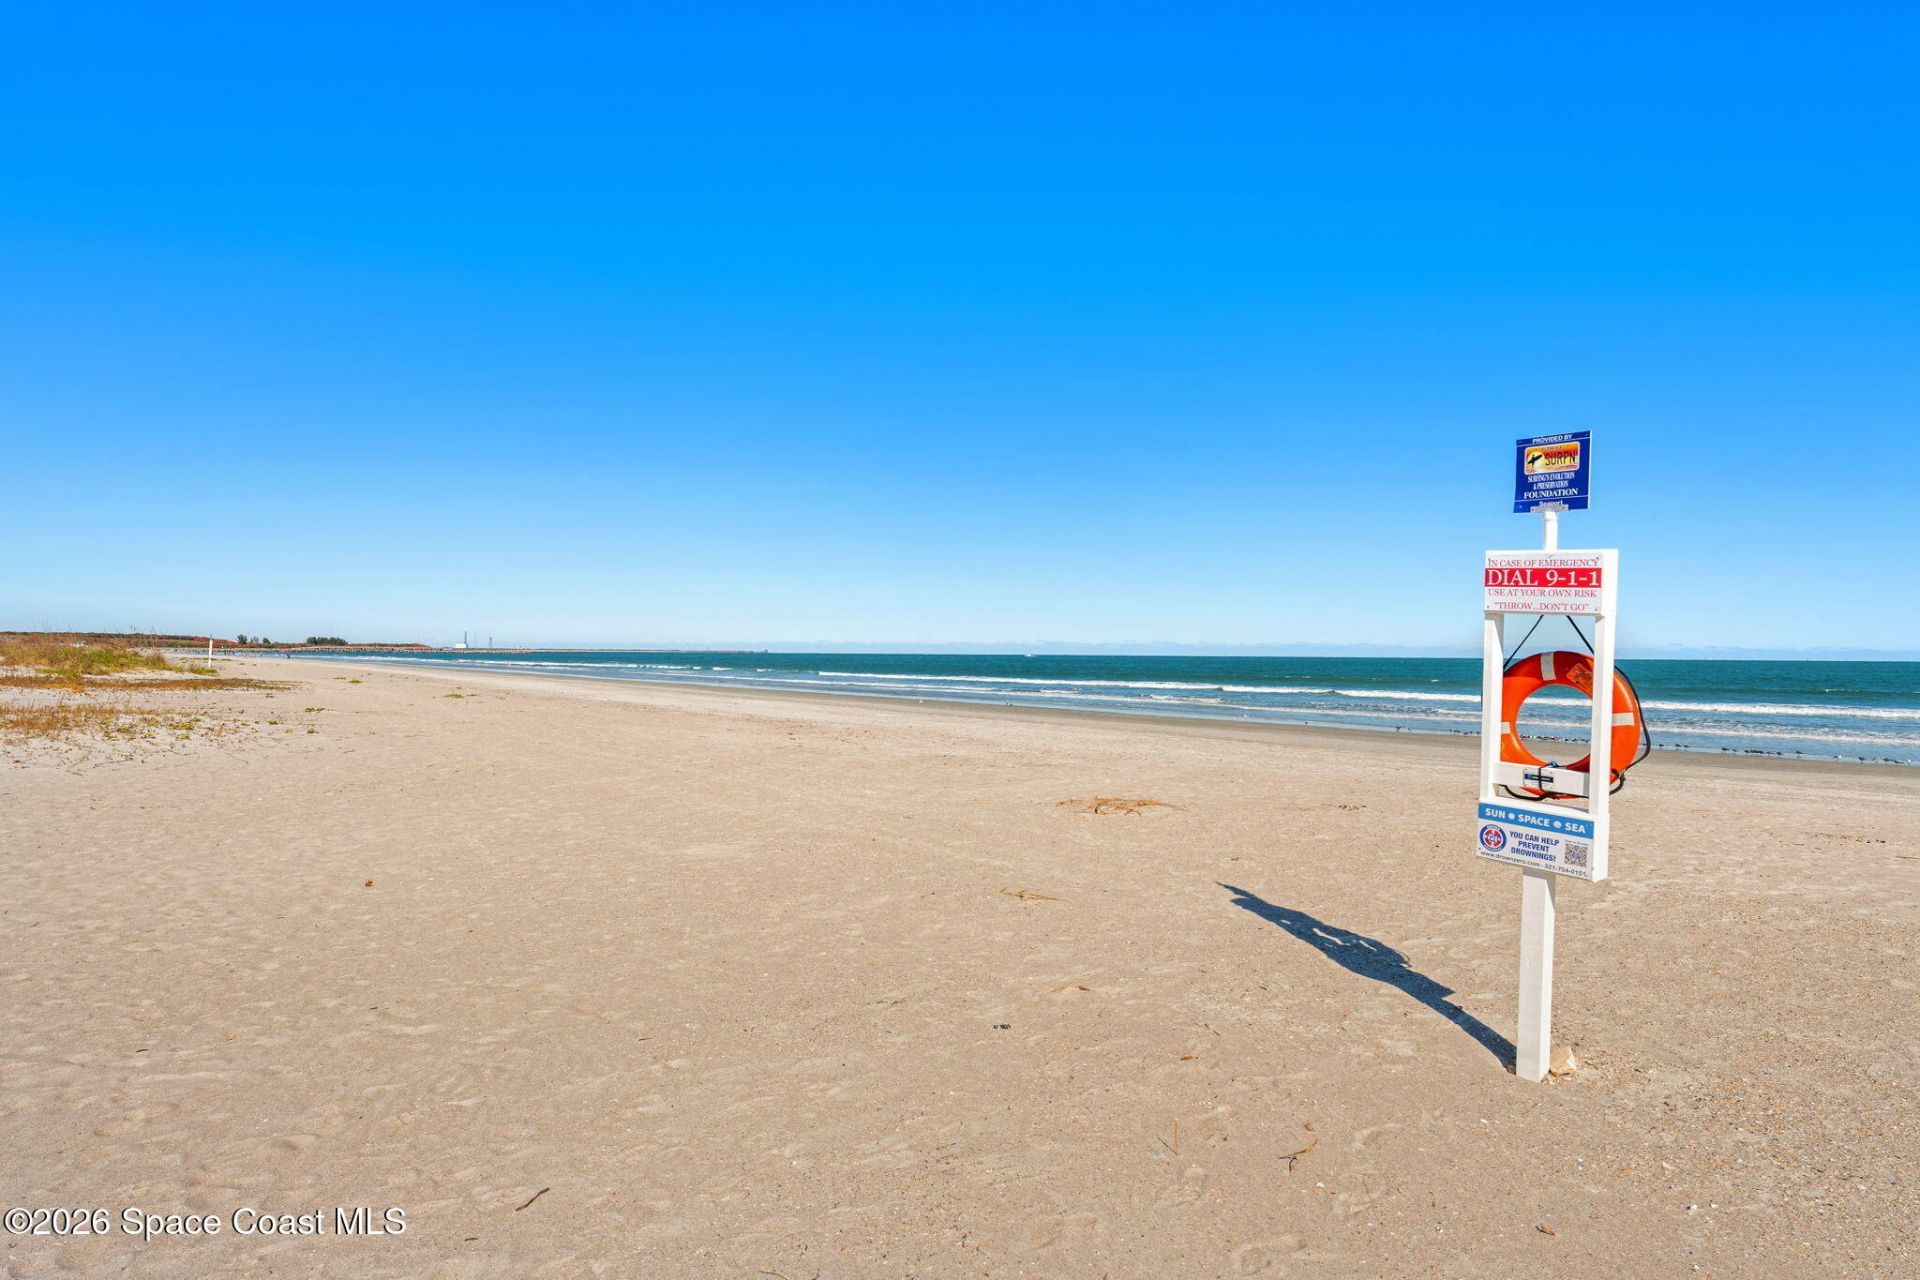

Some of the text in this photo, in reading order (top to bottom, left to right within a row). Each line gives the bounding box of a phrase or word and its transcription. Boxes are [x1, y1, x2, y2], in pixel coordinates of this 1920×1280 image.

[1532, 436, 1563, 444] PROVIDED
[1537, 480, 1569, 490] PRESERVATION
[1524, 488, 1578, 499] FOUNDATION
[1488, 558, 1599, 567] IN CASE OF EMERGENCY
[1487, 569, 1599, 586] DIAL 9-1-1
[1488, 588, 1597, 598] USE AT YOUR OWN RISK
[1485, 807, 1586, 834] SUN SPACE SEA
[1509, 830, 1523, 840] YOU
[1524, 833, 1540, 843] CAN
[1541, 836, 1560, 846] HELP
[1517, 841, 1549, 853] PREVENT
[1511, 847, 1556, 862] DROWNINGS!
